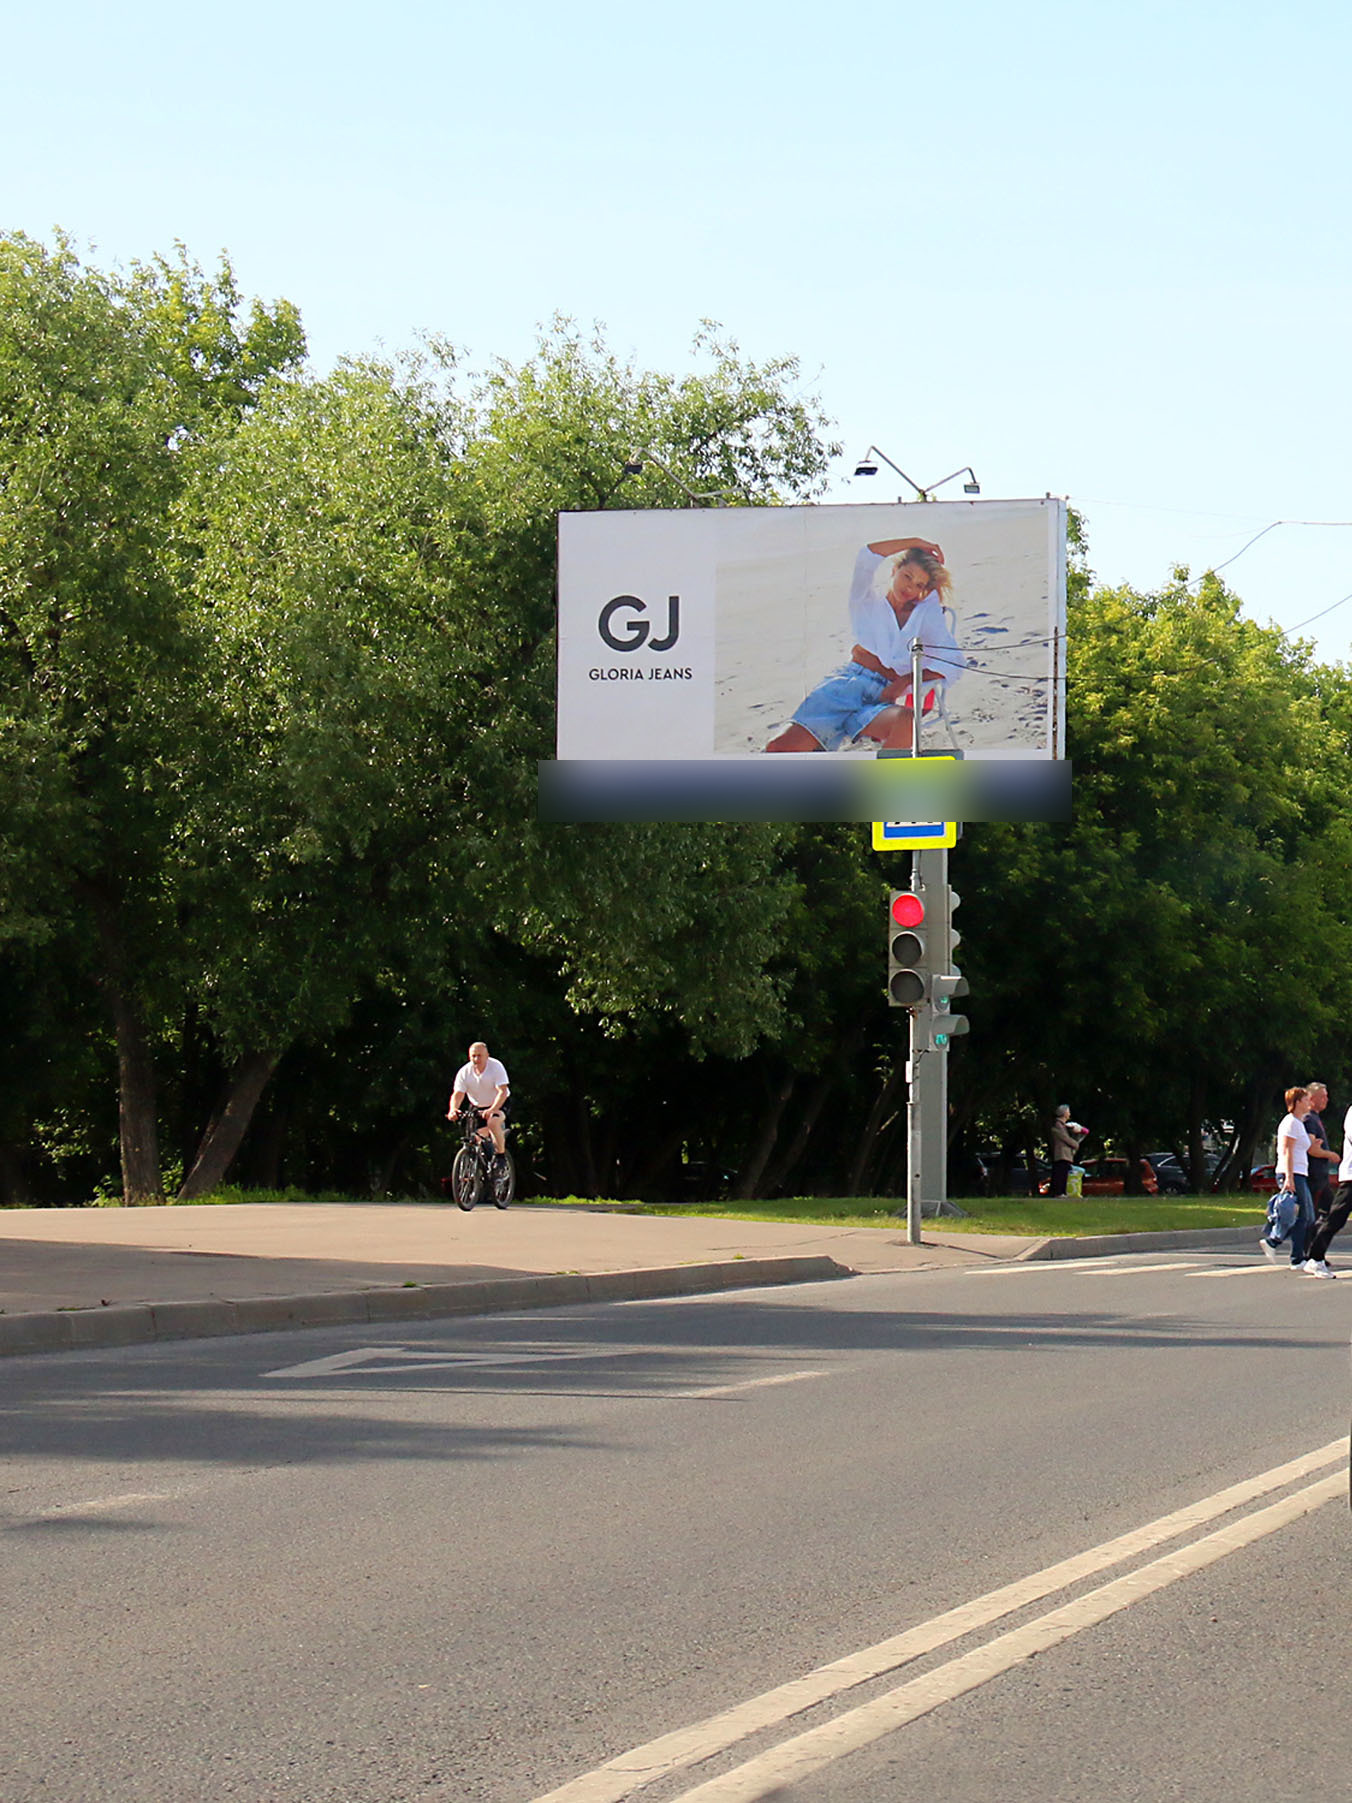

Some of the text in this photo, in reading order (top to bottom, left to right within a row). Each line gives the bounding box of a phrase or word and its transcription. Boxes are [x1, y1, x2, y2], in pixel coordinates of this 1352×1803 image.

[598, 595, 680, 652] GJ
[589, 668, 693, 681] GLORIA JEANS
